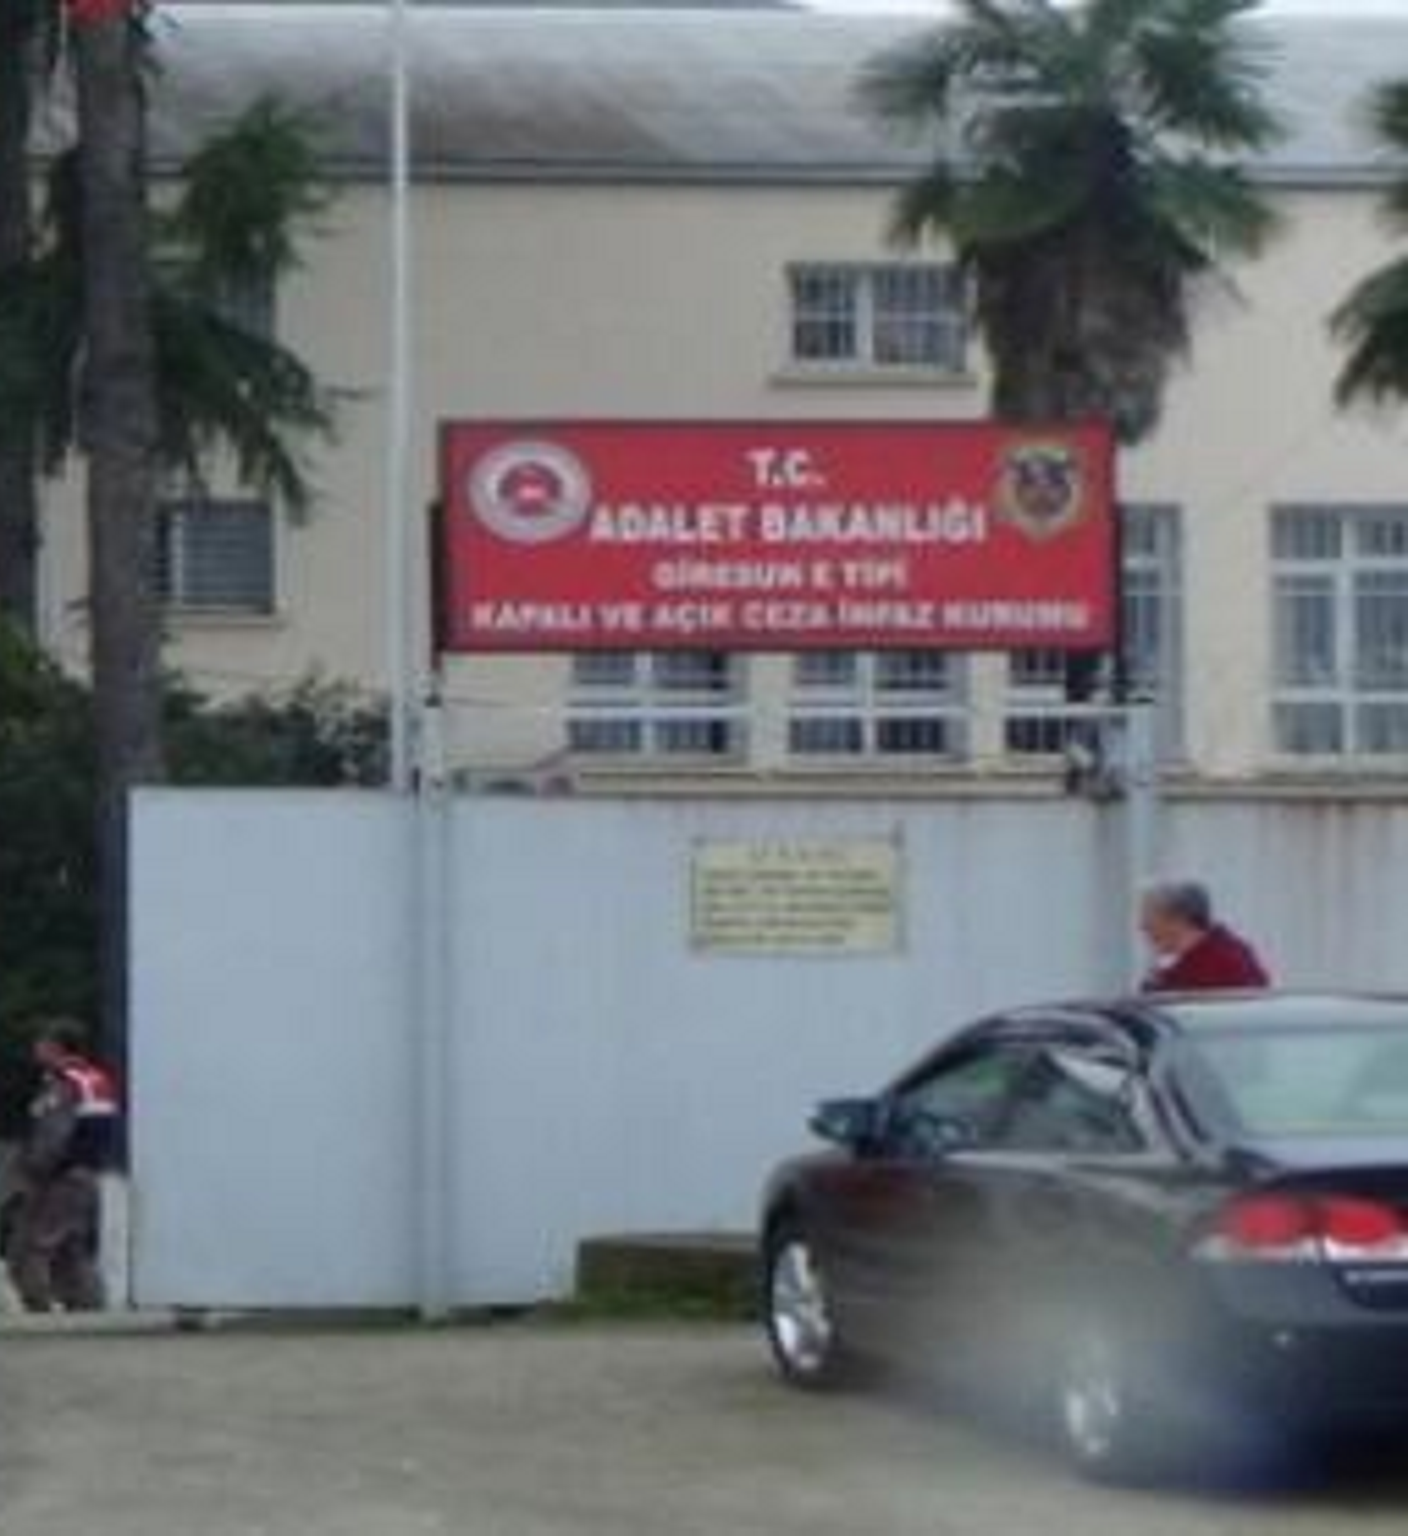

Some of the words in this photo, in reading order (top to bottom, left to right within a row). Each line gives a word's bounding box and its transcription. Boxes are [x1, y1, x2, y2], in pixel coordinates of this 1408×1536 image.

[746, 448, 826, 487] T.C.
[590, 504, 748, 541] ADALET
[760, 497, 986, 541] BAKANLIĞI
[811, 562, 832, 588] E
[472, 602, 592, 630] KAPALI
[600, 602, 642, 630] VE
[649, 602, 732, 635] AÇIK
[741, 602, 832, 630] CEZA
